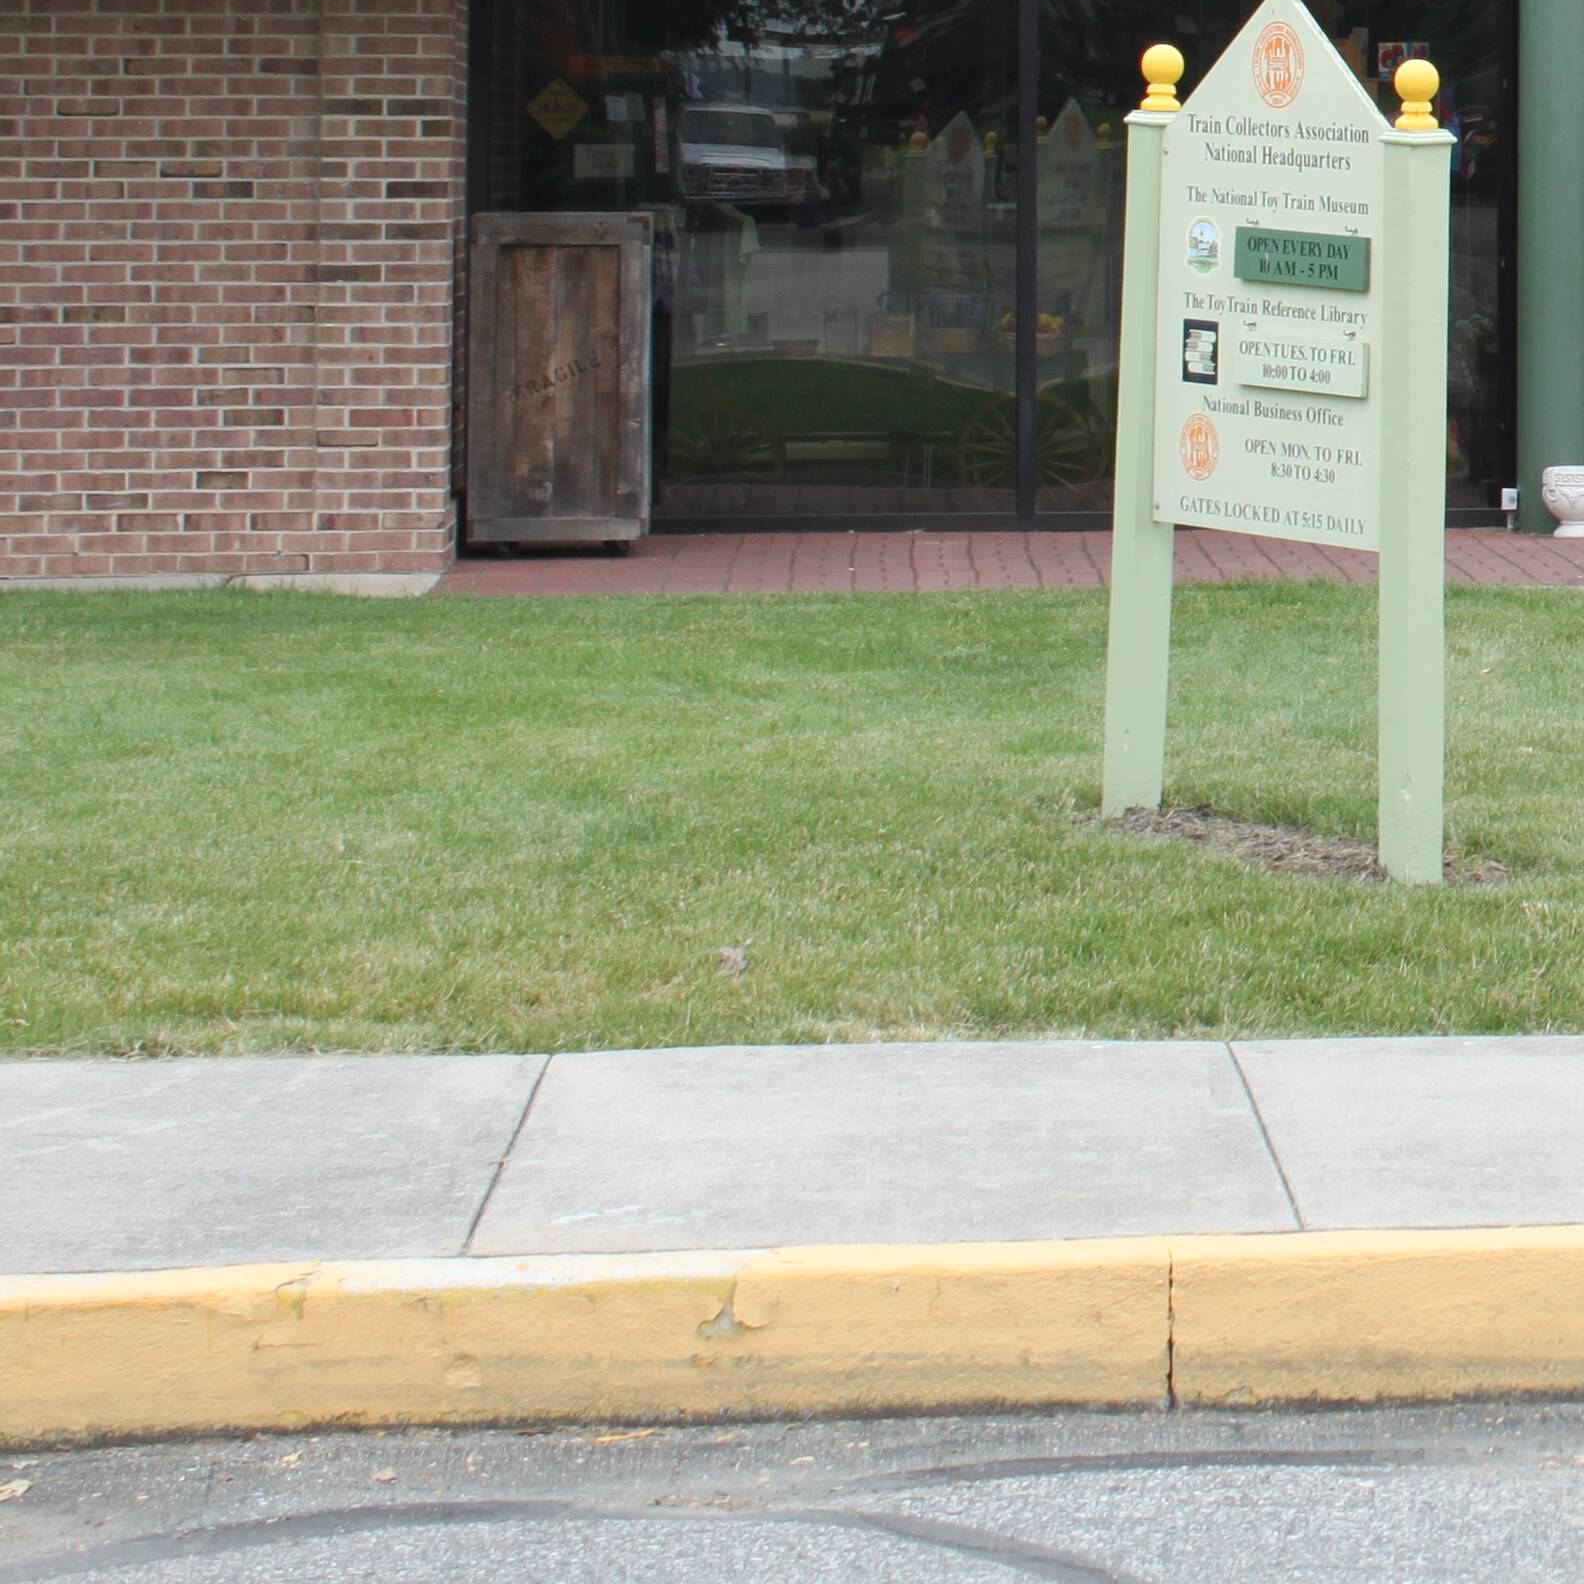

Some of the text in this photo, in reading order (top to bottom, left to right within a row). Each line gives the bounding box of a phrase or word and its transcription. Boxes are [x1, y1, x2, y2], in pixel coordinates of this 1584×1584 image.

[1188, 114, 1369, 144] Train Collectors Association
[1204, 142, 1351, 173] National Headquarters
[1186, 186, 1369, 215] The National Toy Train Museum
[1247, 236, 1352, 261] OPEN EVERY DAY
[1259, 258, 1271, 274] 10
[1274, 260, 1296, 276] AM
[1308, 263, 1315, 278] 5
[1318, 264, 1339, 281] PM
[1184, 291, 1369, 330] The Toy Train Reference Library
[1239, 340, 1271, 358] OPEN
[1310, 346, 1327, 363] TO
[1329, 348, 1357, 366] FRI.
[511, 350, 601, 402] FRAGILE
[1262, 363, 1332, 384] 10:00 TO 4:00
[1202, 395, 1345, 427] National Business Office
[1244, 438, 1277, 456] OPEN
[1314, 446, 1332, 463] TO
[1336, 448, 1363, 466] FRI.
[1270, 462, 1335, 484] 8:30 TO 4:30
[1180, 495, 1367, 535] GATES LOCKED AT 5:15 DAILY
